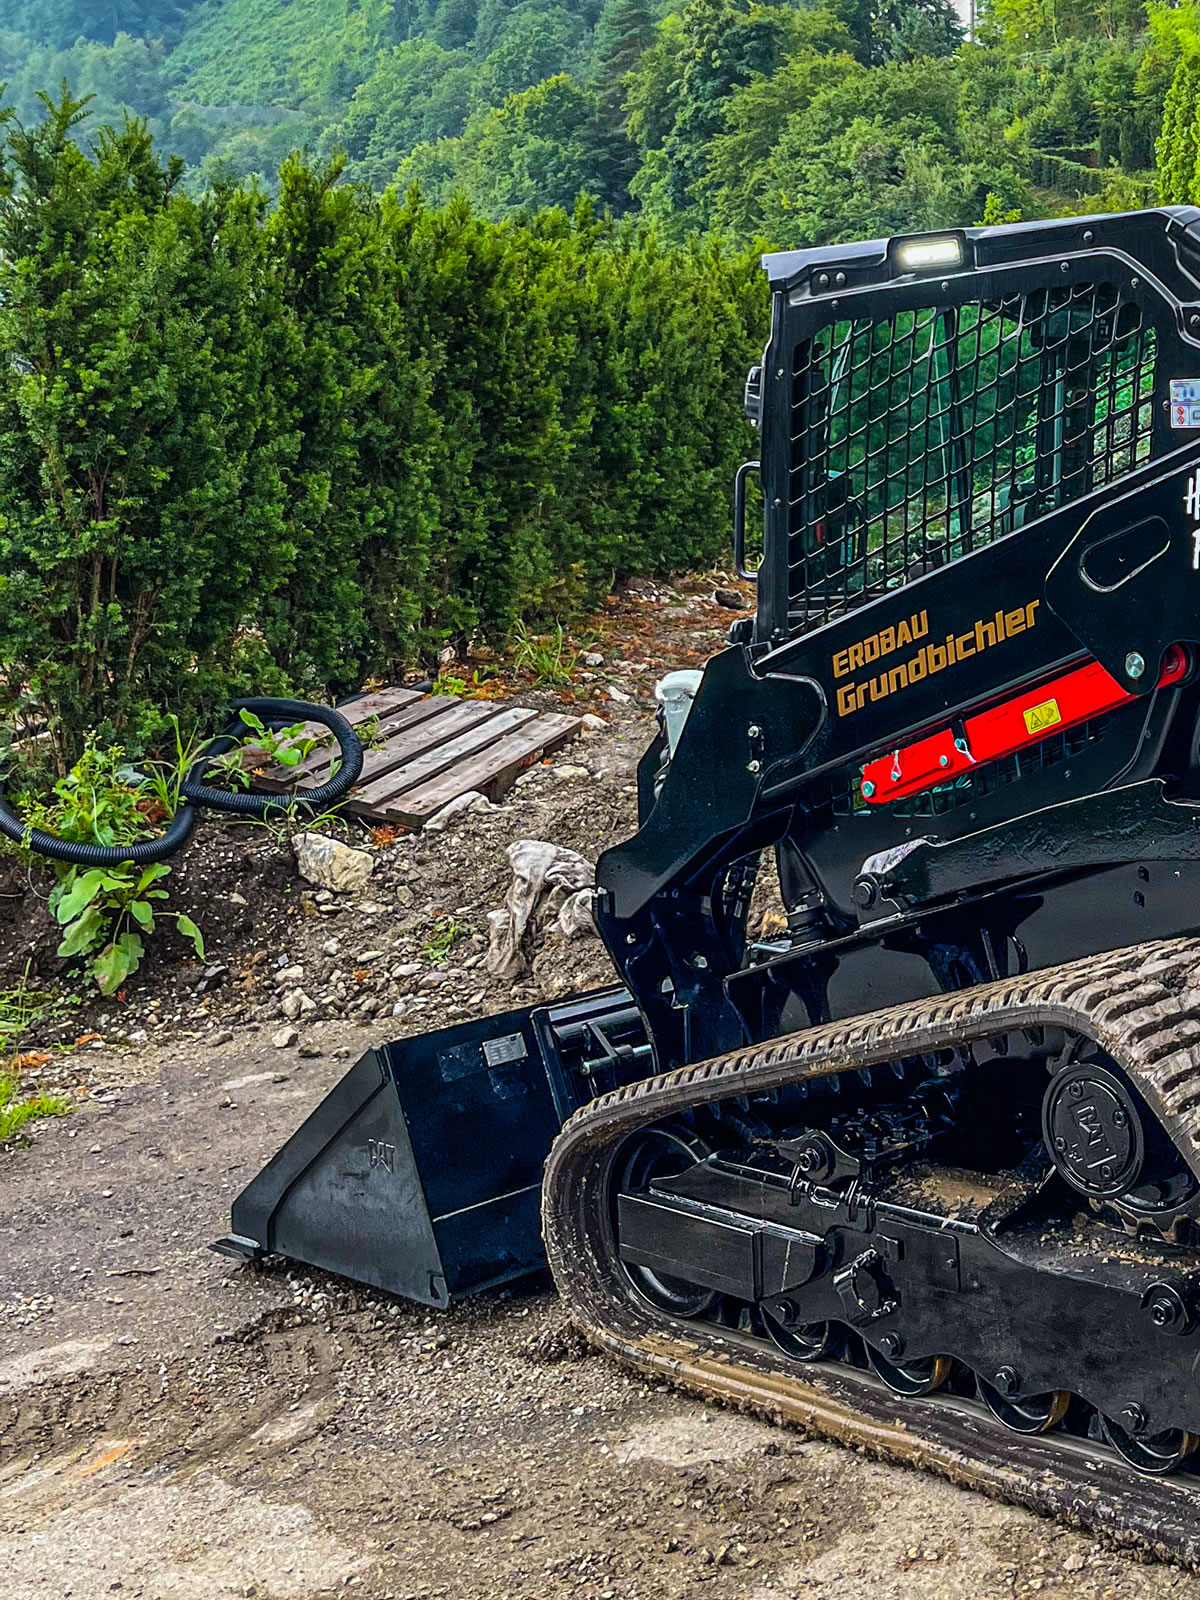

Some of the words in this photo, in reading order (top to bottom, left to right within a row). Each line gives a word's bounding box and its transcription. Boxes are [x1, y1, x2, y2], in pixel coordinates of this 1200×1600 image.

[832, 609, 929, 679] ERDBAU
[836, 600, 1040, 717] Grundbichler
[1076, 1105, 1106, 1147] CAT
[368, 1138, 396, 1174] CAT
